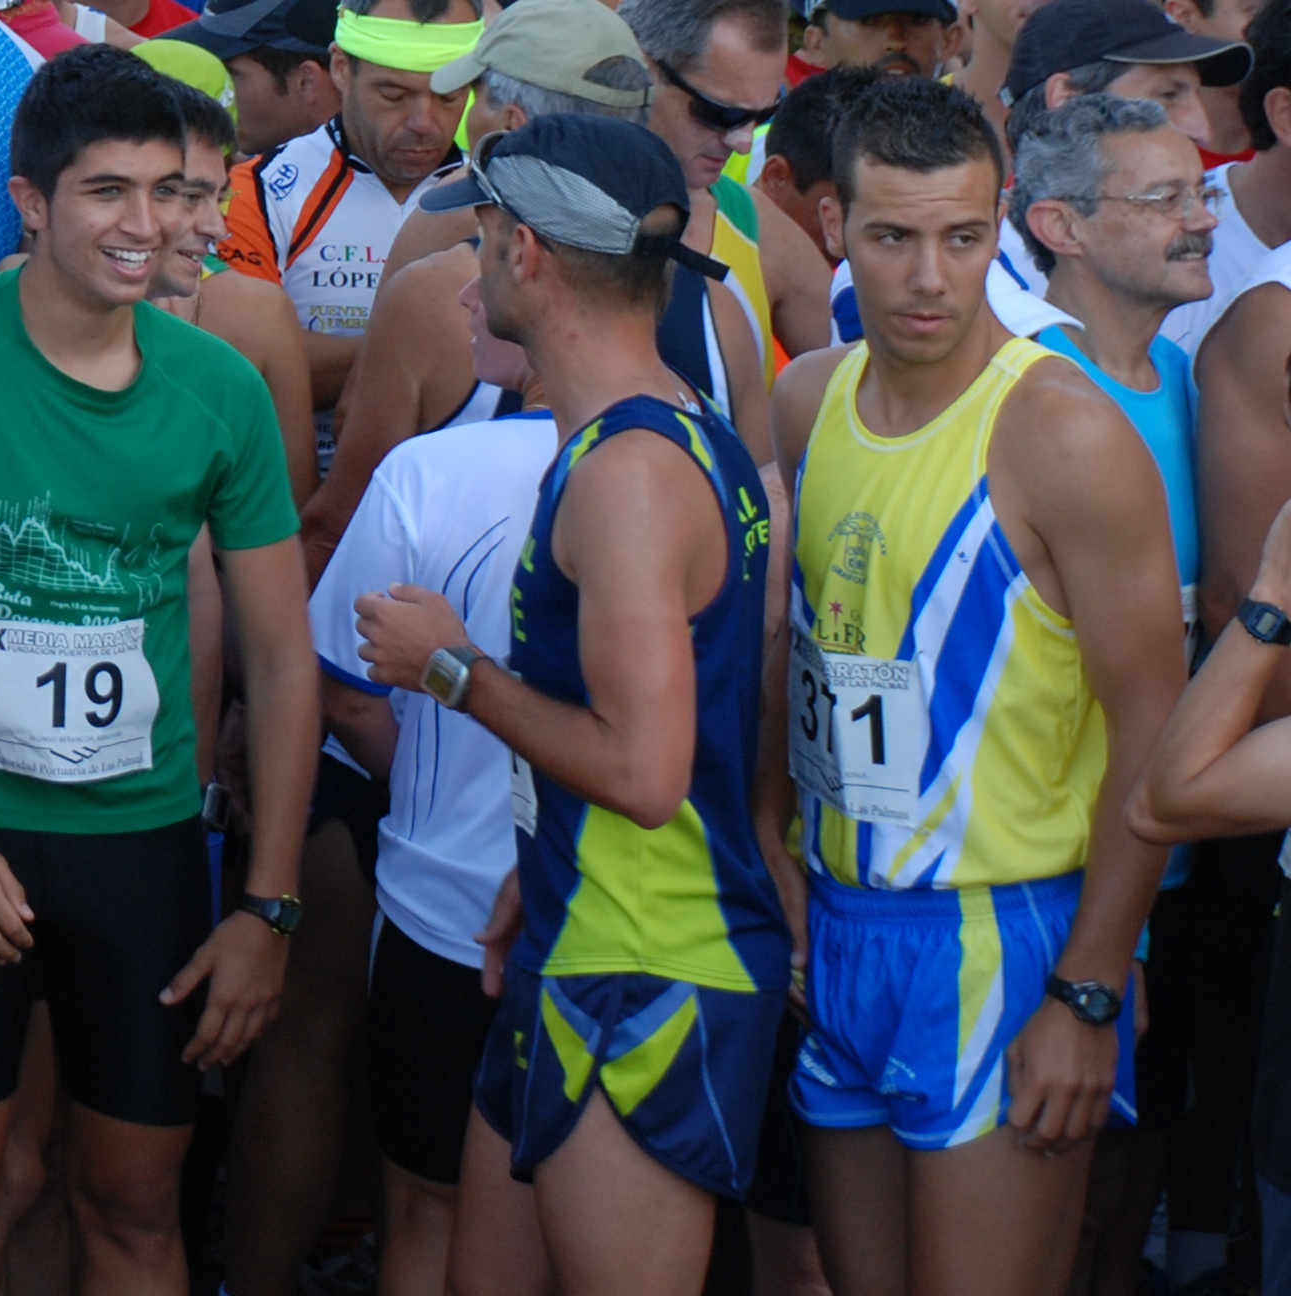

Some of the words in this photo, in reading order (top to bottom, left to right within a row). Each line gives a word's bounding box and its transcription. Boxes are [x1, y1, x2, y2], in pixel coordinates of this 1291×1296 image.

[312, 266, 380, 289] LÓPE
[6, 629, 69, 648] MEDIA
[7, 645, 56, 656] FUNDACIÓN
[59, 649, 98, 657] PUERTOS
[100, 648, 111, 656] DE
[823, 662, 909, 682] ARATÓN
[834, 679, 846, 687] DE
[848, 680, 867, 688] LAS
[871, 680, 909, 690] PALMAS
[36, 661, 124, 728] 19
[39, 764, 87, 777] Portuaria
[88, 764, 99, 774] de
[101, 760, 116, 772] Las
[849, 802, 869, 815] Las
[870, 805, 910, 820] Palmas
